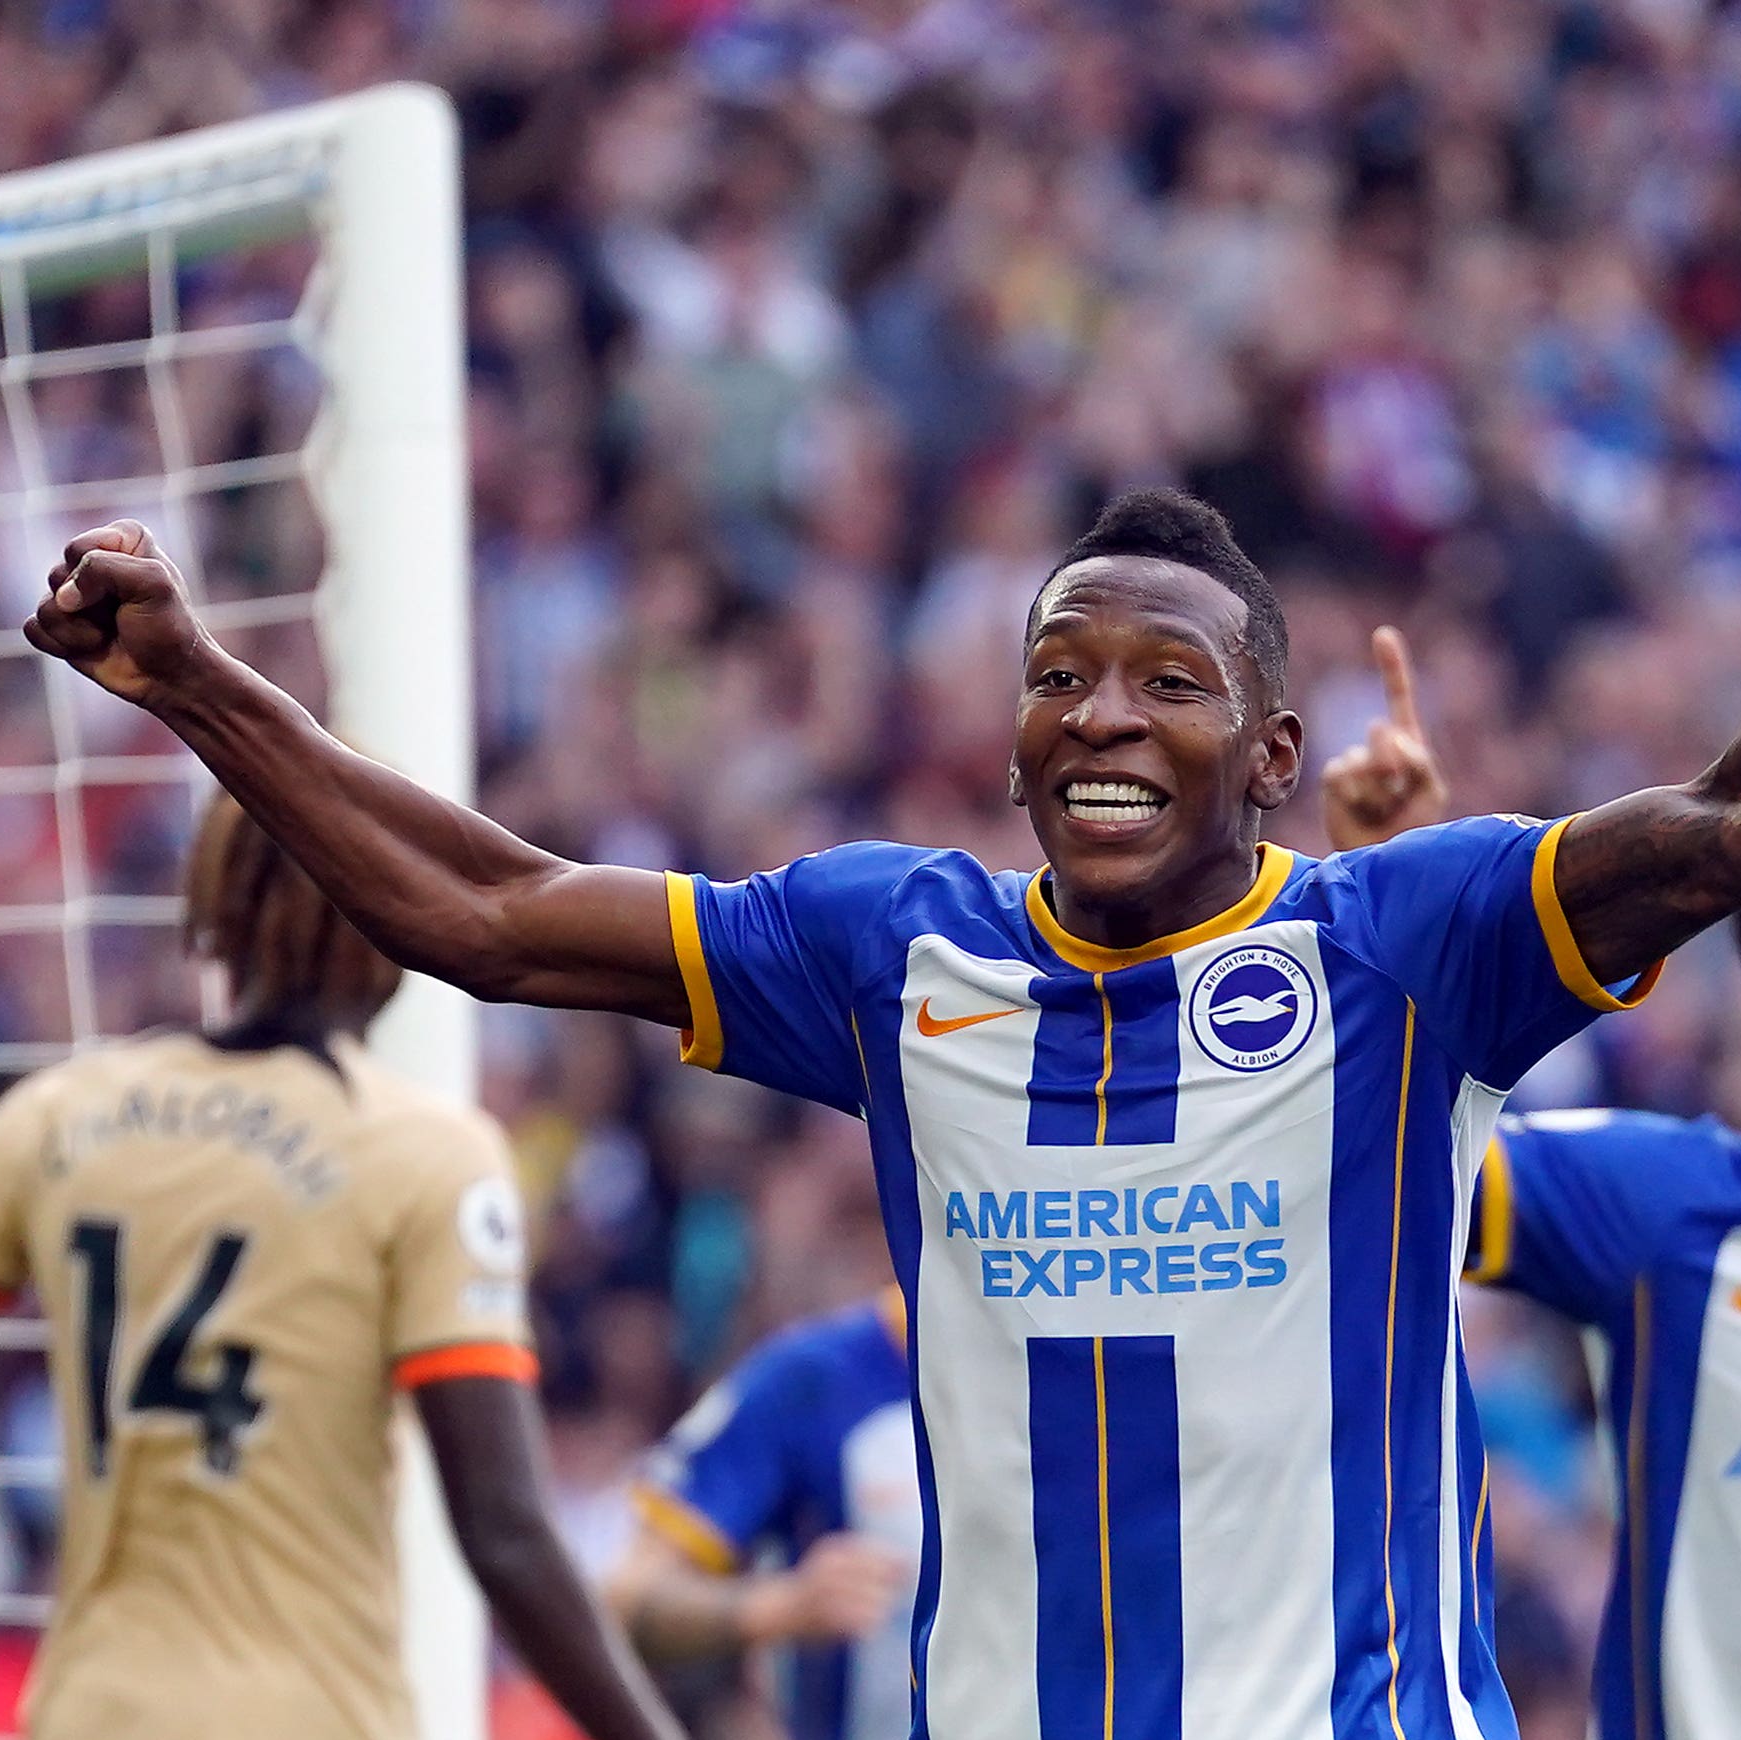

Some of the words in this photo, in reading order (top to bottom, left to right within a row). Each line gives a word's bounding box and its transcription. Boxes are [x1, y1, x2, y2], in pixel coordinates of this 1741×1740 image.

[1203, 952, 1255, 991] BRIGHTON
[1260, 952, 1269, 961] &
[1272, 955, 1301, 980] HOVE
[1231, 1050, 1280, 1066] ALBION
[945, 1180, 1281, 1239] AMERICAN
[981, 1237, 1288, 1298] EXPRESS
[66, 1215, 266, 1482] 14
